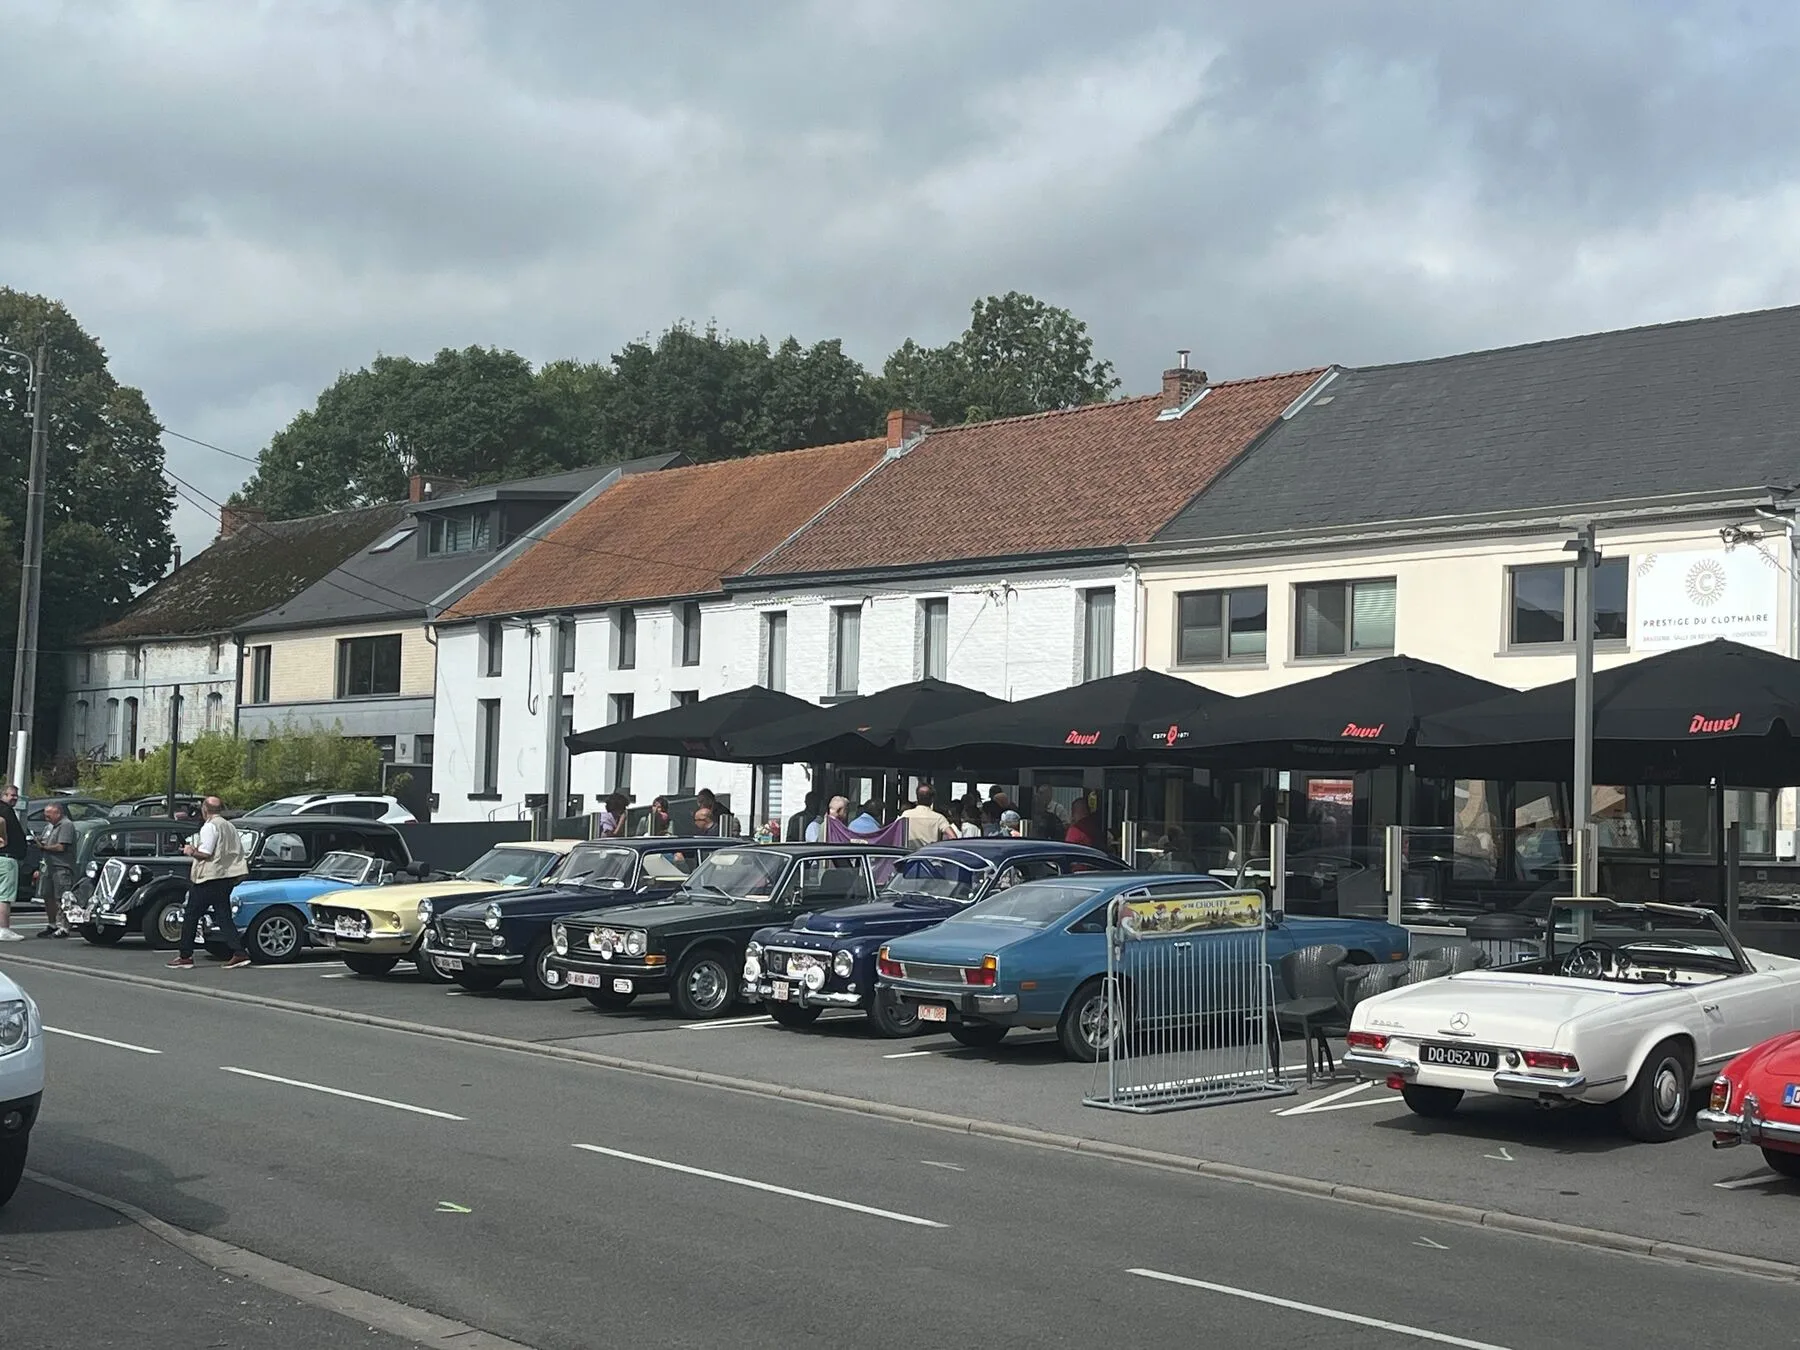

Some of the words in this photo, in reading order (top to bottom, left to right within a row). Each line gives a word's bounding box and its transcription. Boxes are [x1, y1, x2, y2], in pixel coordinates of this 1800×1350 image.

[1643, 618, 1689, 627] PRESTIGE
[1694, 617, 1707, 625] DU
[1711, 614, 1769, 624] CLOTHAIRE
[1341, 723, 1384, 738] Duvel
[1689, 713, 1741, 733] Duvel
[1065, 730, 1100, 745] Duvel
[1428, 1047, 1490, 1067] DQ-052-VD
